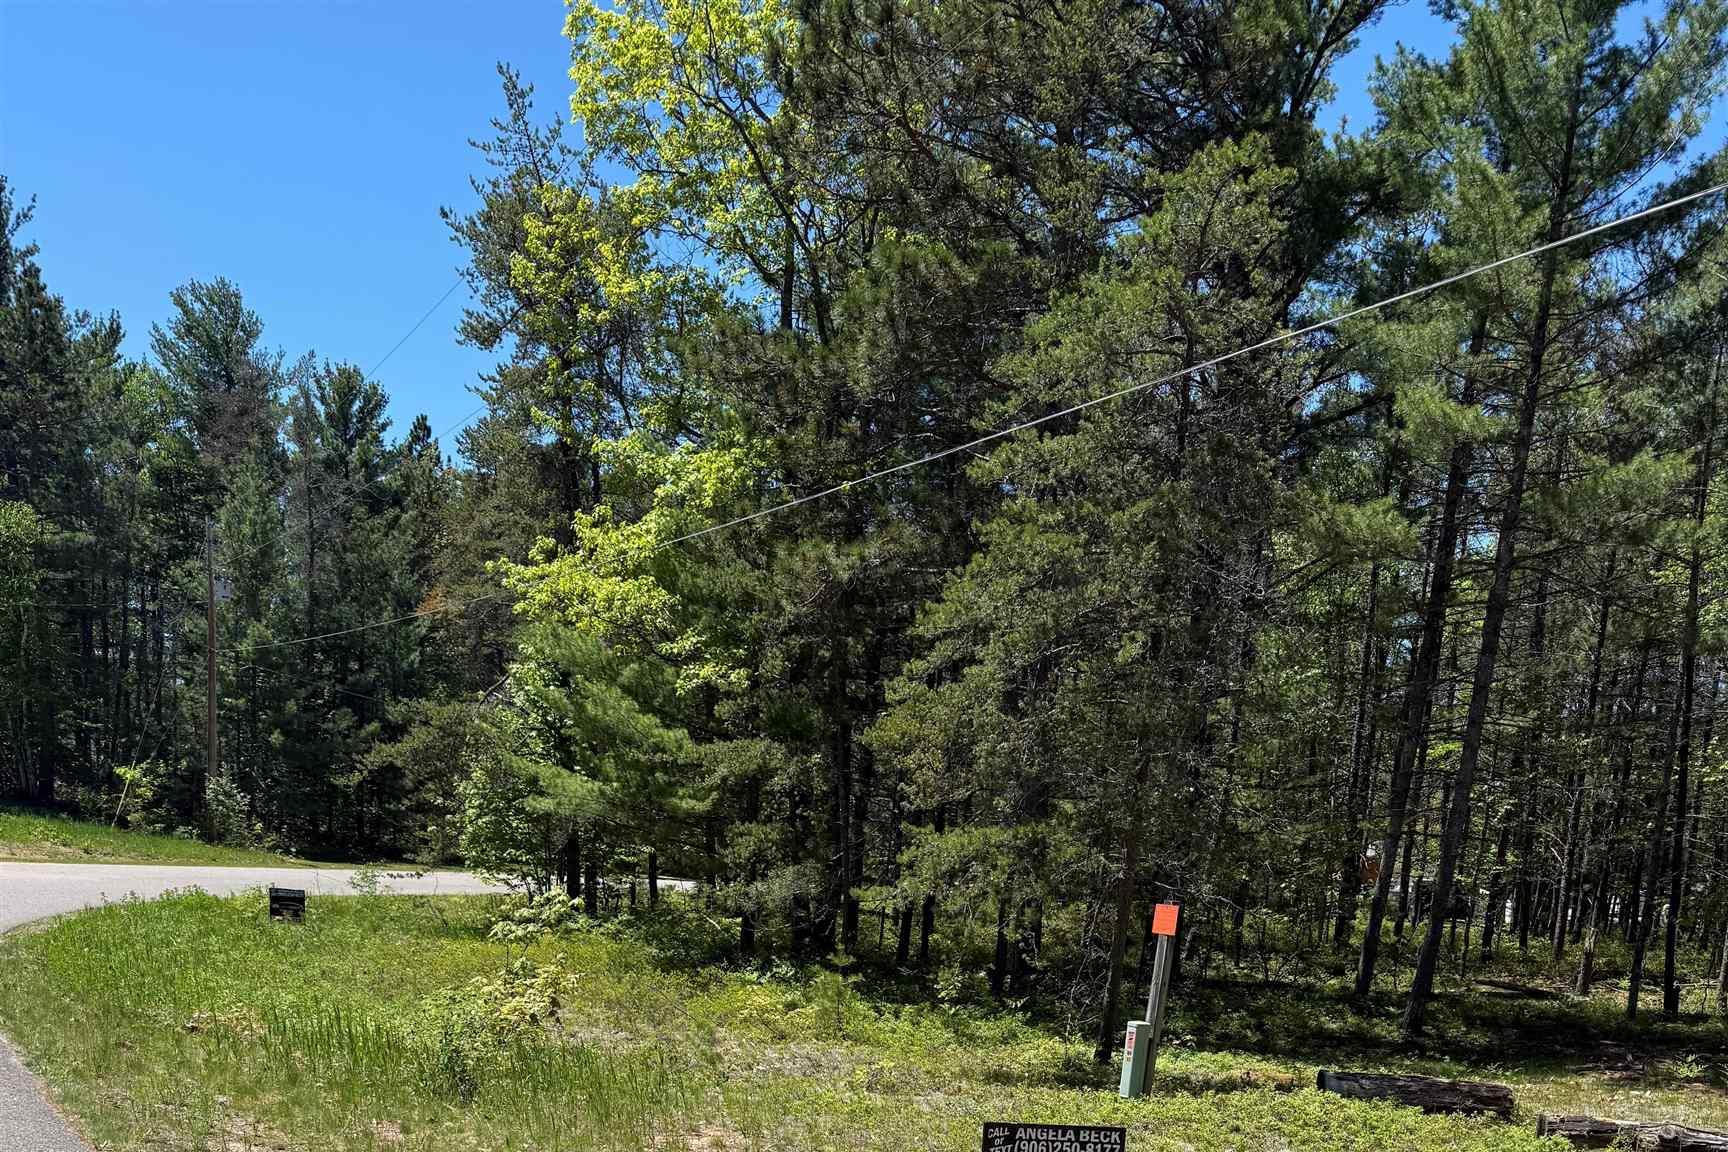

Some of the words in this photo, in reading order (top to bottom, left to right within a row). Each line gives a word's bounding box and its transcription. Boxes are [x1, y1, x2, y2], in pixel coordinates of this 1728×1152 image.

[988, 1127, 1010, 1139] CALL
[1015, 1128, 1075, 1141] ANGELA
[1079, 1130, 1121, 1143] BECK
[994, 1138, 1005, 1146] or
